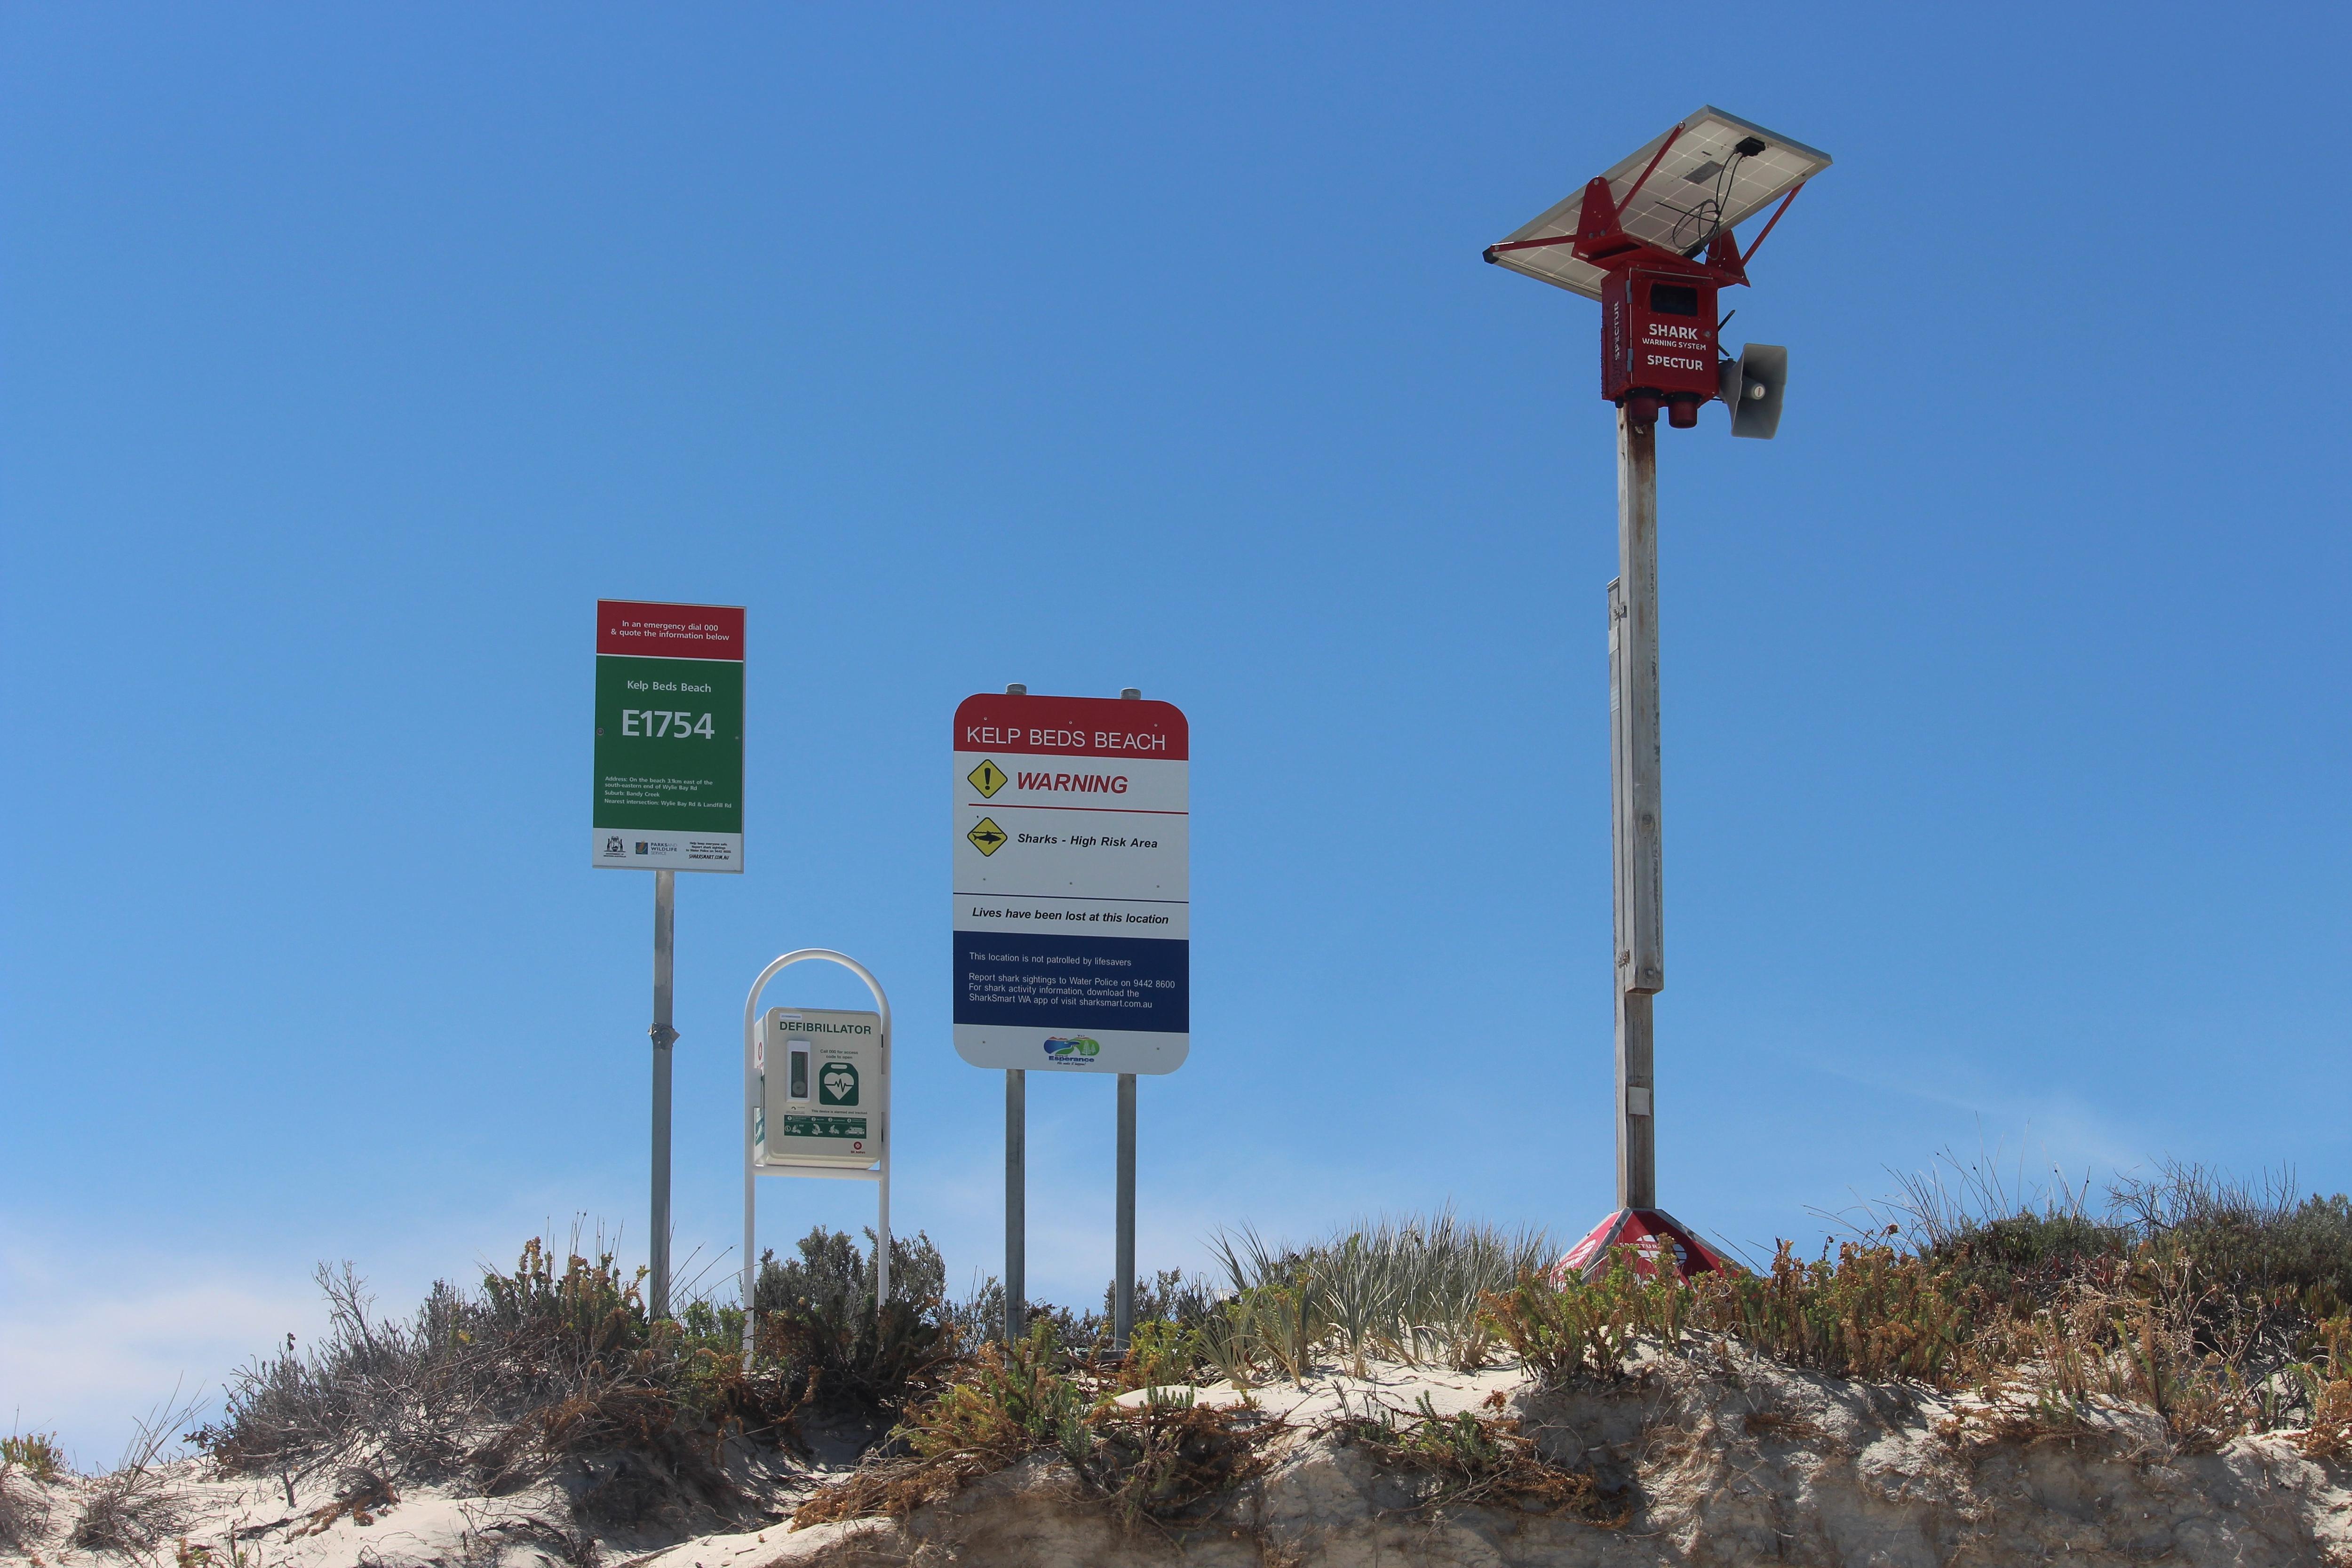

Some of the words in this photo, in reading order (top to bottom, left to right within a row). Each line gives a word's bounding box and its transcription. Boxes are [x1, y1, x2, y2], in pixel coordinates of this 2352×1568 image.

[1650, 324, 1697, 341] SHARK
[1642, 338, 1676, 347] WARNING
[1648, 355, 1702, 370] SPECTUR
[628, 681, 648, 691] Kelp
[653, 682, 676, 691] Beds
[682, 683, 711, 692] Beach
[623, 710, 715, 739] E1754
[968, 727, 1020, 744] KELP
[1030, 729, 1085, 747] BEDS
[1096, 732, 1165, 750] BEACH
[1018, 772, 1128, 793] WARNING
[1018, 834, 1057, 844] Sharks
[1071, 836, 1096, 847] High
[1101, 837, 1126, 846] Risk
[1130, 838, 1157, 848] Area
[973, 907, 1001, 917] Lives
[1006, 909, 1031, 918] have
[1035, 910, 1062, 920] been
[1066, 911, 1086, 921] lost
[1103, 913, 1122, 922] this
[1126, 914, 1168, 923] location
[1083, 957, 1091, 966] by
[1095, 957, 1131, 966] lifesavers
[969, 973, 995, 982] Report
[1023, 975, 1056, 985] sightings
[1009, 985, 1036, 995] activity
[1040, 986, 1083, 995] information,
[1087, 988, 1123, 996] download
[969, 994, 1015, 1002] SharkSmart
[1080, 998, 1152, 1008] sharksmart.com.au
[780, 1022, 871, 1034] DEFIBRILLATOR
